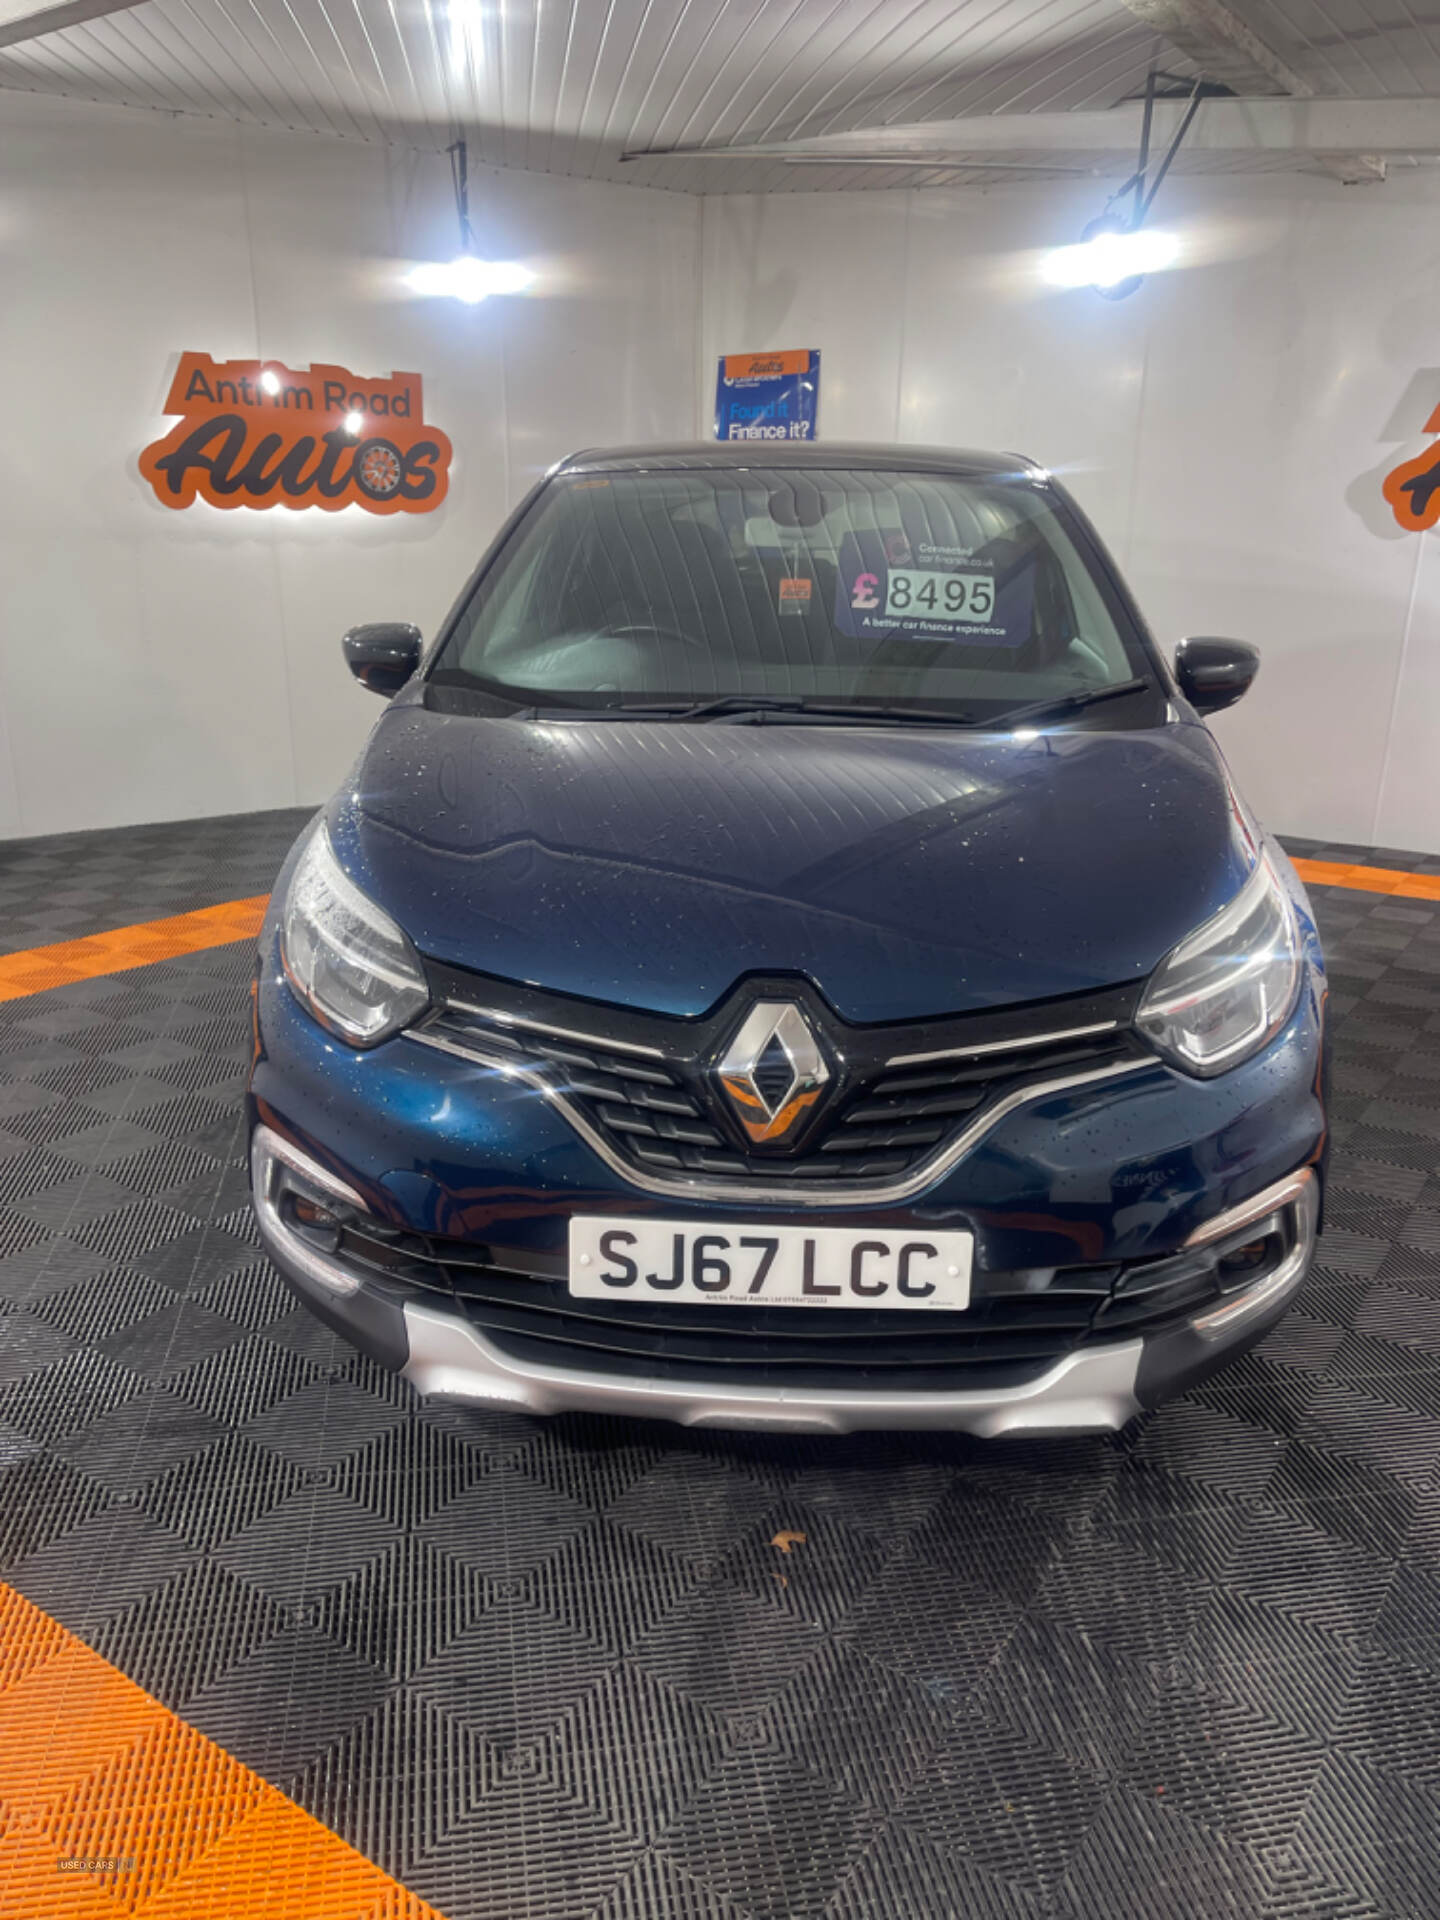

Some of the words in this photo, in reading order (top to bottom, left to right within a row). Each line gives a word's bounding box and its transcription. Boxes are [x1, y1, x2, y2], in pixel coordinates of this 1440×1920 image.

[323, 381, 411, 417] Road
[730, 402, 775, 419] Found
[777, 401, 788, 418] it
[729, 423, 786, 440] Finance
[790, 421, 810, 438] it?
[154, 413, 440, 500] Autos
[862, 617, 871, 627] A
[872, 618, 900, 628] better
[902, 620, 918, 630] car
[920, 621, 953, 632] finance
[956, 626, 1006, 636] experience
[599, 1230, 780, 1294] SJ67
[803, 1239, 939, 1298] LCC
